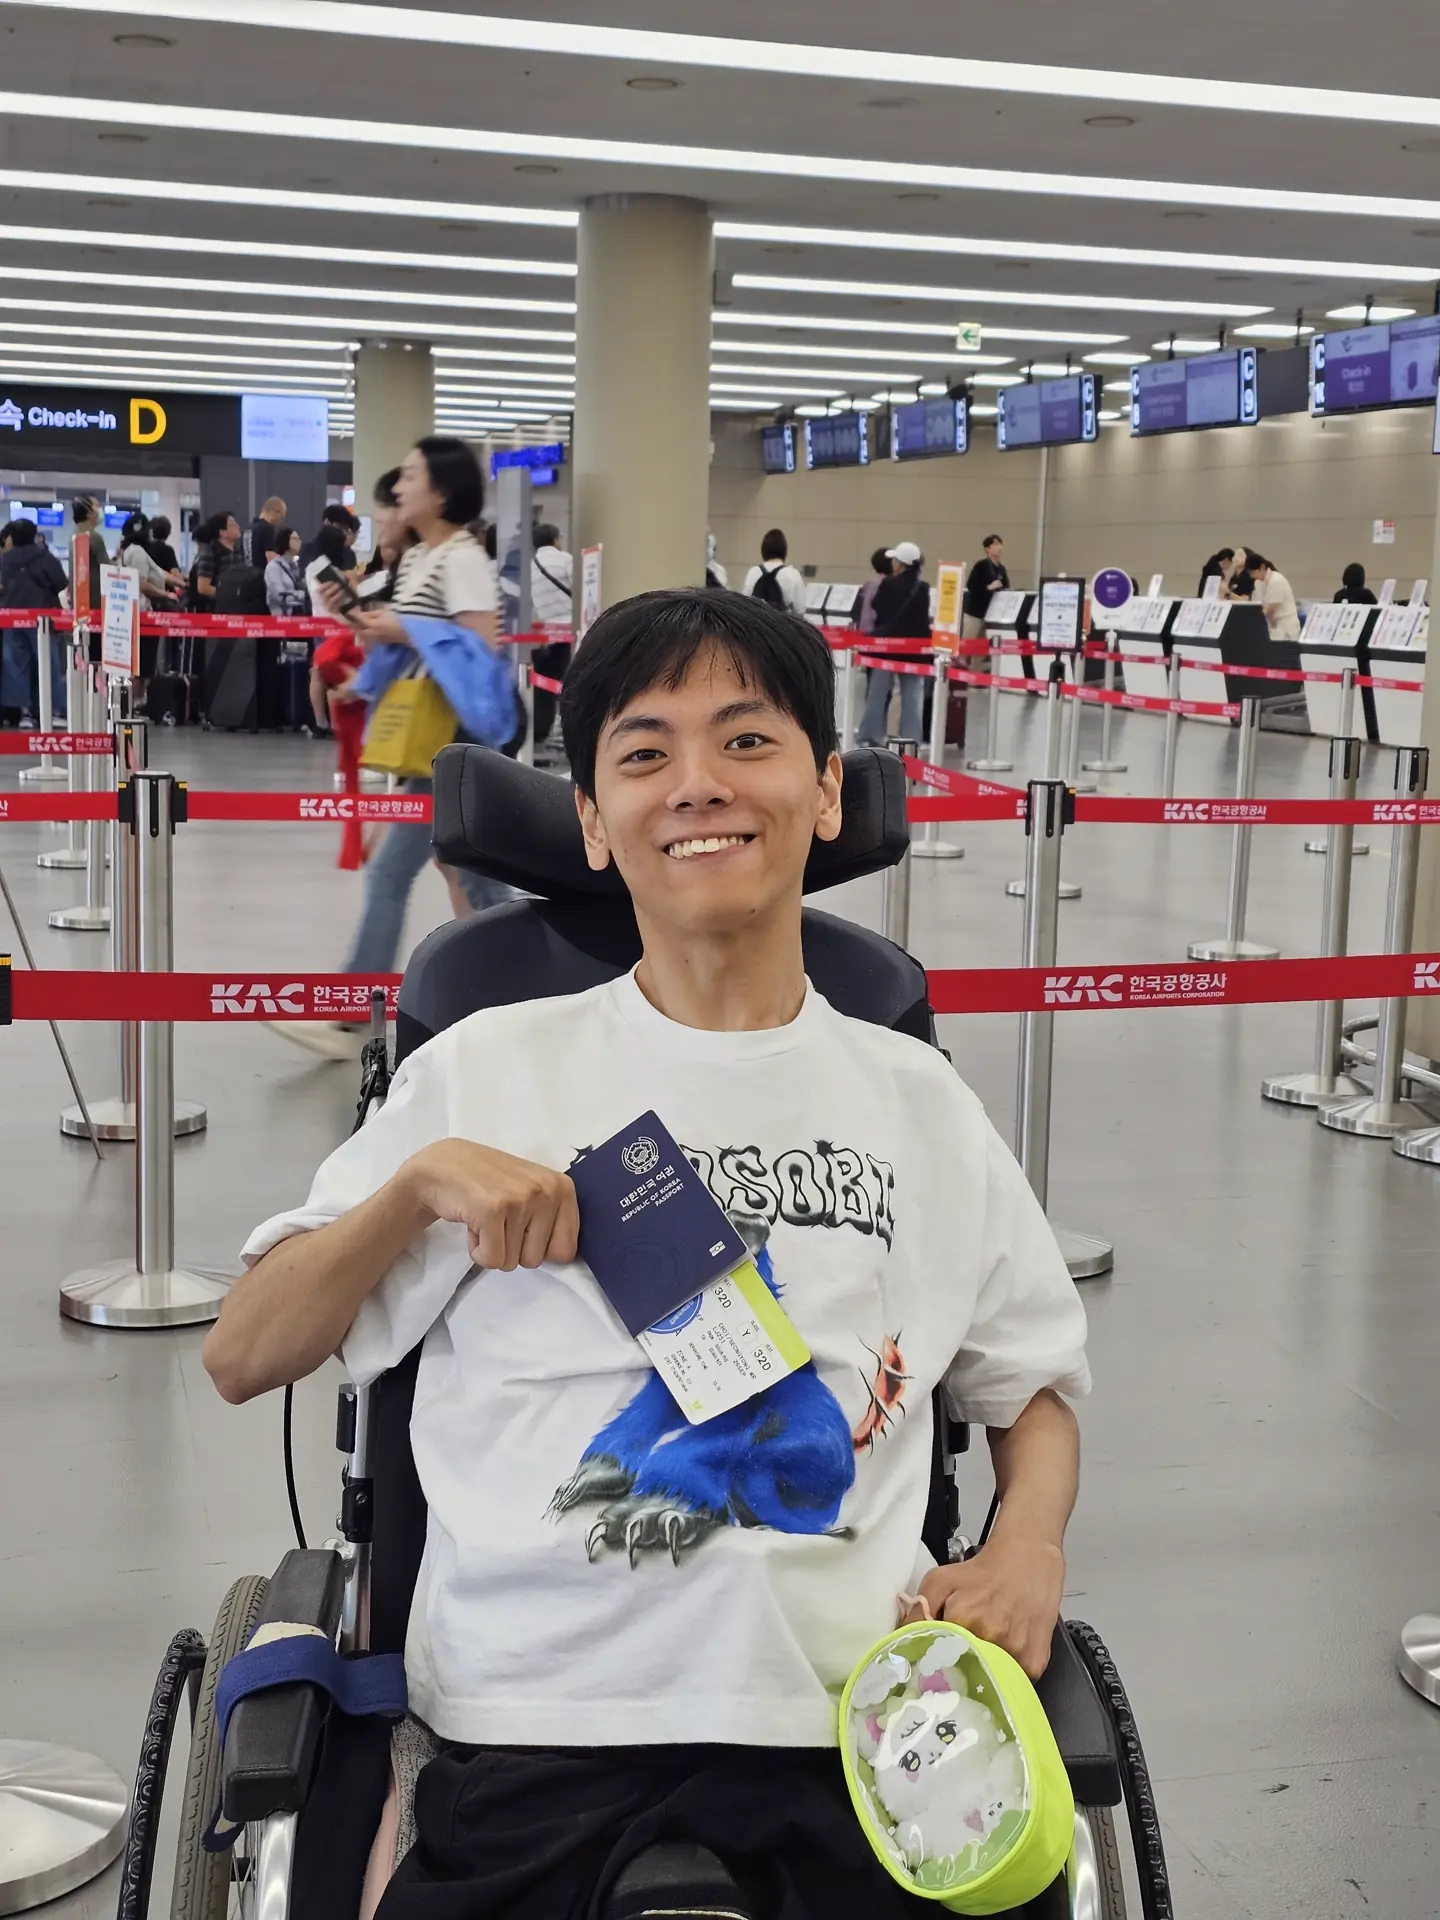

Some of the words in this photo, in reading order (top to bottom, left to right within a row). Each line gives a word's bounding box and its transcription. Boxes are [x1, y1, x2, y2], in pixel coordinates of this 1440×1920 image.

[28, 406, 117, 430] Check-in
[130, 398, 167, 444] D
[29, 736, 72, 752] KAC
[300, 799, 354, 817] KAC
[1164, 803, 1209, 820] KAC
[1373, 804, 1416, 820] KAC
[1413, 962, 1440, 989] K
[210, 983, 304, 1014] KAC
[1043, 974, 1123, 1004] KAC
[1130, 973, 1227, 992] 한국공항공사
[313, 1005, 338, 1013] KOREA
[620, 1178, 656, 1208] 대한민국
[655, 1164, 675, 1181] 여권
[655, 1182, 684, 1207] PASSPORT
[621, 1198, 650, 1222] REPUBLIC
[650, 1192, 660, 1201] OF
[659, 1177, 681, 1195] KOREA
[714, 1286, 732, 1309] 32D
[742, 1329, 751, 1337] Y
[753, 1349, 772, 1371] 32D
